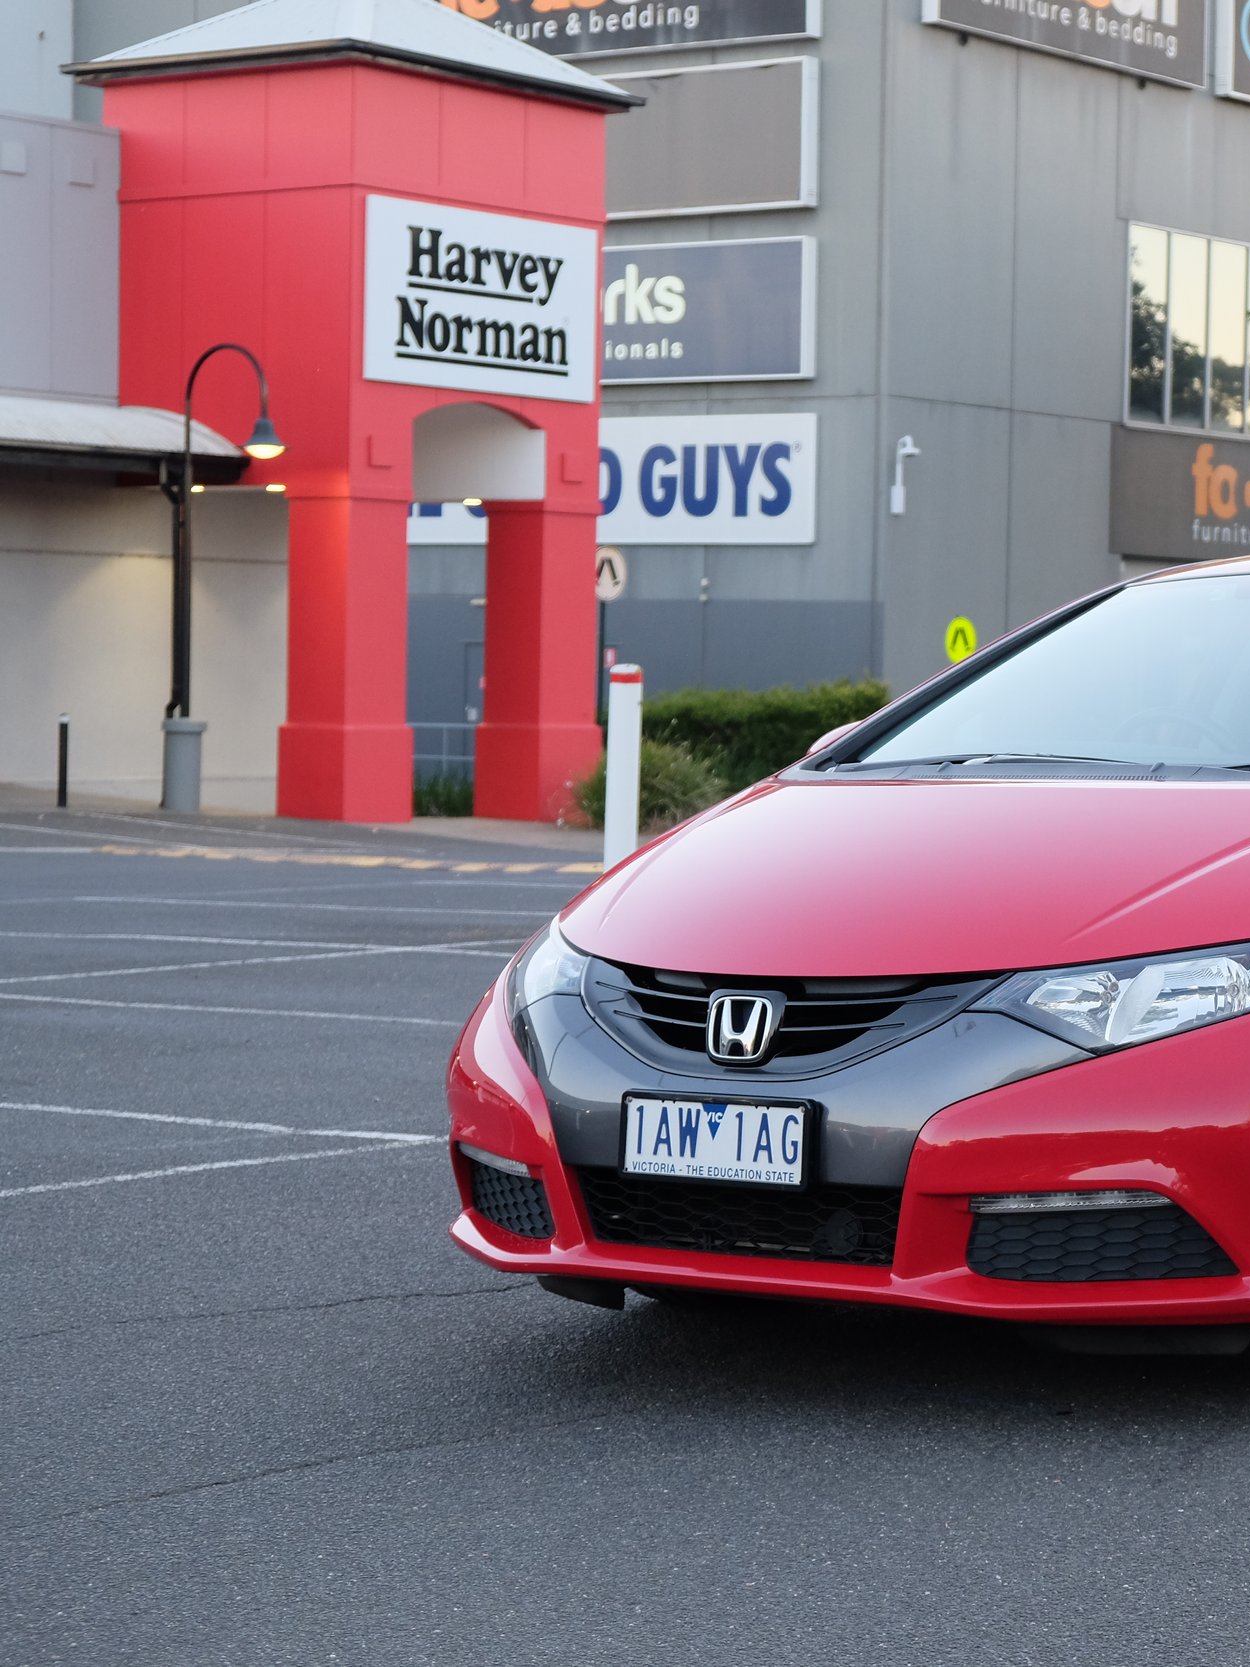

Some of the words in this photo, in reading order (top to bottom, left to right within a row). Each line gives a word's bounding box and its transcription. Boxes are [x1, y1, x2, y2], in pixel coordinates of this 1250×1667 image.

[565, 12, 582, 37] &
[588, 4, 700, 35] bedding
[1077, 6, 1091, 31] &
[1095, 10, 1178, 59] bedding
[407, 225, 564, 306] Harvey
[396, 295, 568, 365] Norman
[604, 337, 684, 360] ionals
[639, 441, 792, 518] GUYS
[636, 1104, 701, 1158] 1AW
[735, 1111, 800, 1165] 1AG
[631, 1161, 676, 1174] VICTORIA
[686, 1165, 704, 1176] THE
[707, 1166, 762, 1180] EDUCATION
[765, 1170, 795, 1182] STATE
